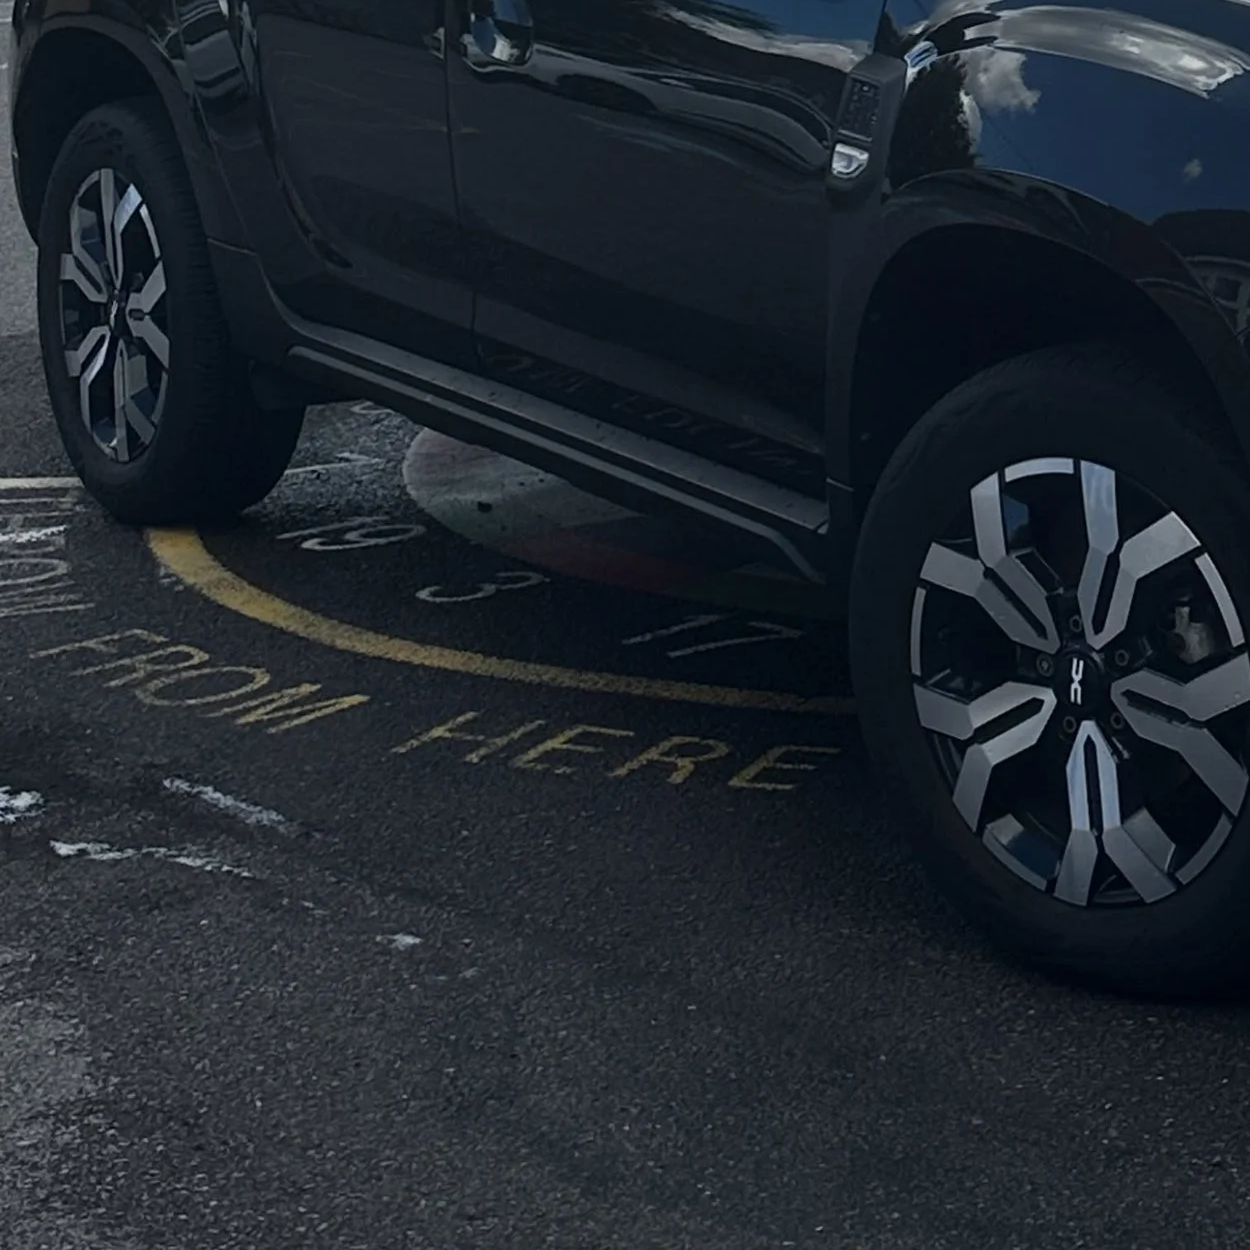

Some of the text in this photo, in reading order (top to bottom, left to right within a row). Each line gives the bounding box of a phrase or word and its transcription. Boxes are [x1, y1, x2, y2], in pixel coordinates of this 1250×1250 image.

[275, 515, 427, 551] 19
[415, 570, 559, 604] 3
[621, 613, 802, 659] 17
[28, 628, 841, 791] FROM HERE
